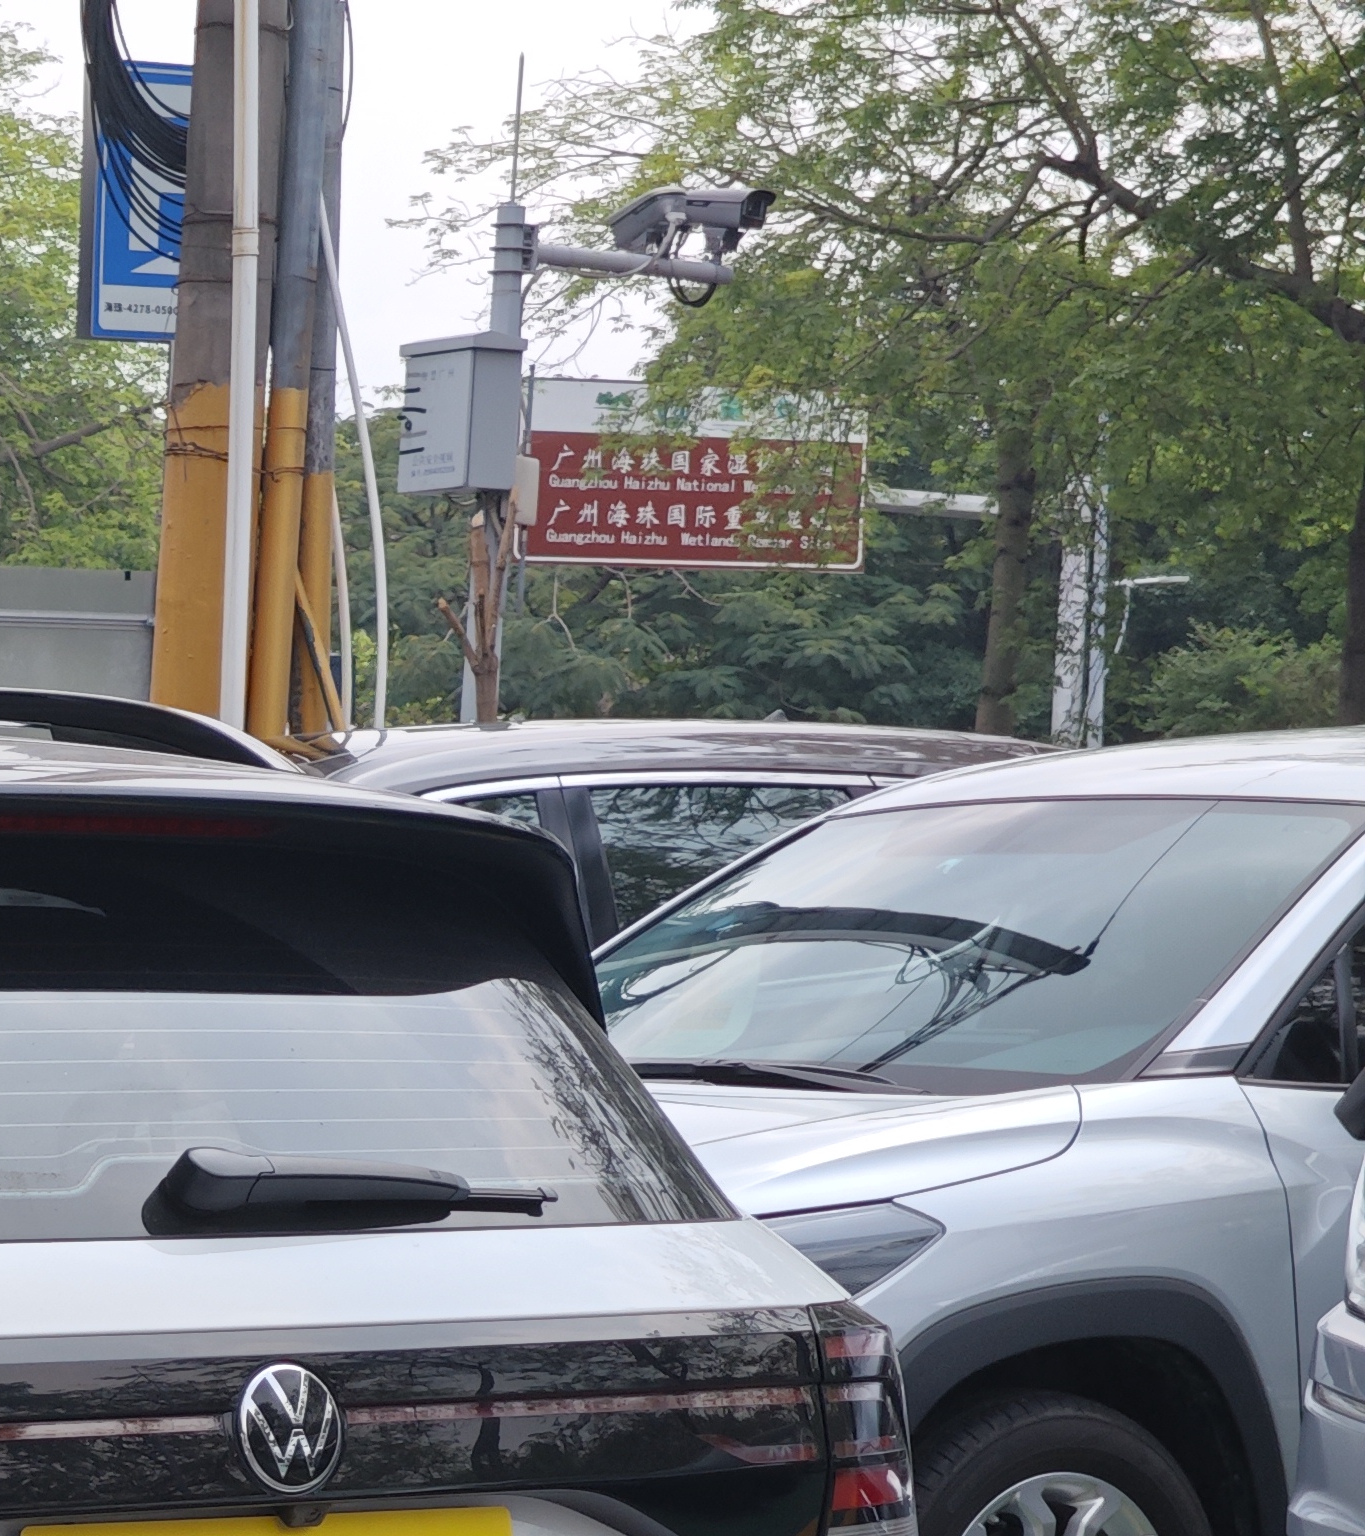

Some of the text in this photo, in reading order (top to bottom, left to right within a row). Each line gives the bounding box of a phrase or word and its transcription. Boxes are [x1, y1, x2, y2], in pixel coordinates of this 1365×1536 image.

[549, 474, 618, 491] Guangzhou
[624, 476, 670, 491] Haizhu
[676, 478, 735, 493] National
[546, 529, 615, 545] Guangzhou
[621, 531, 667, 546] Haizhu
